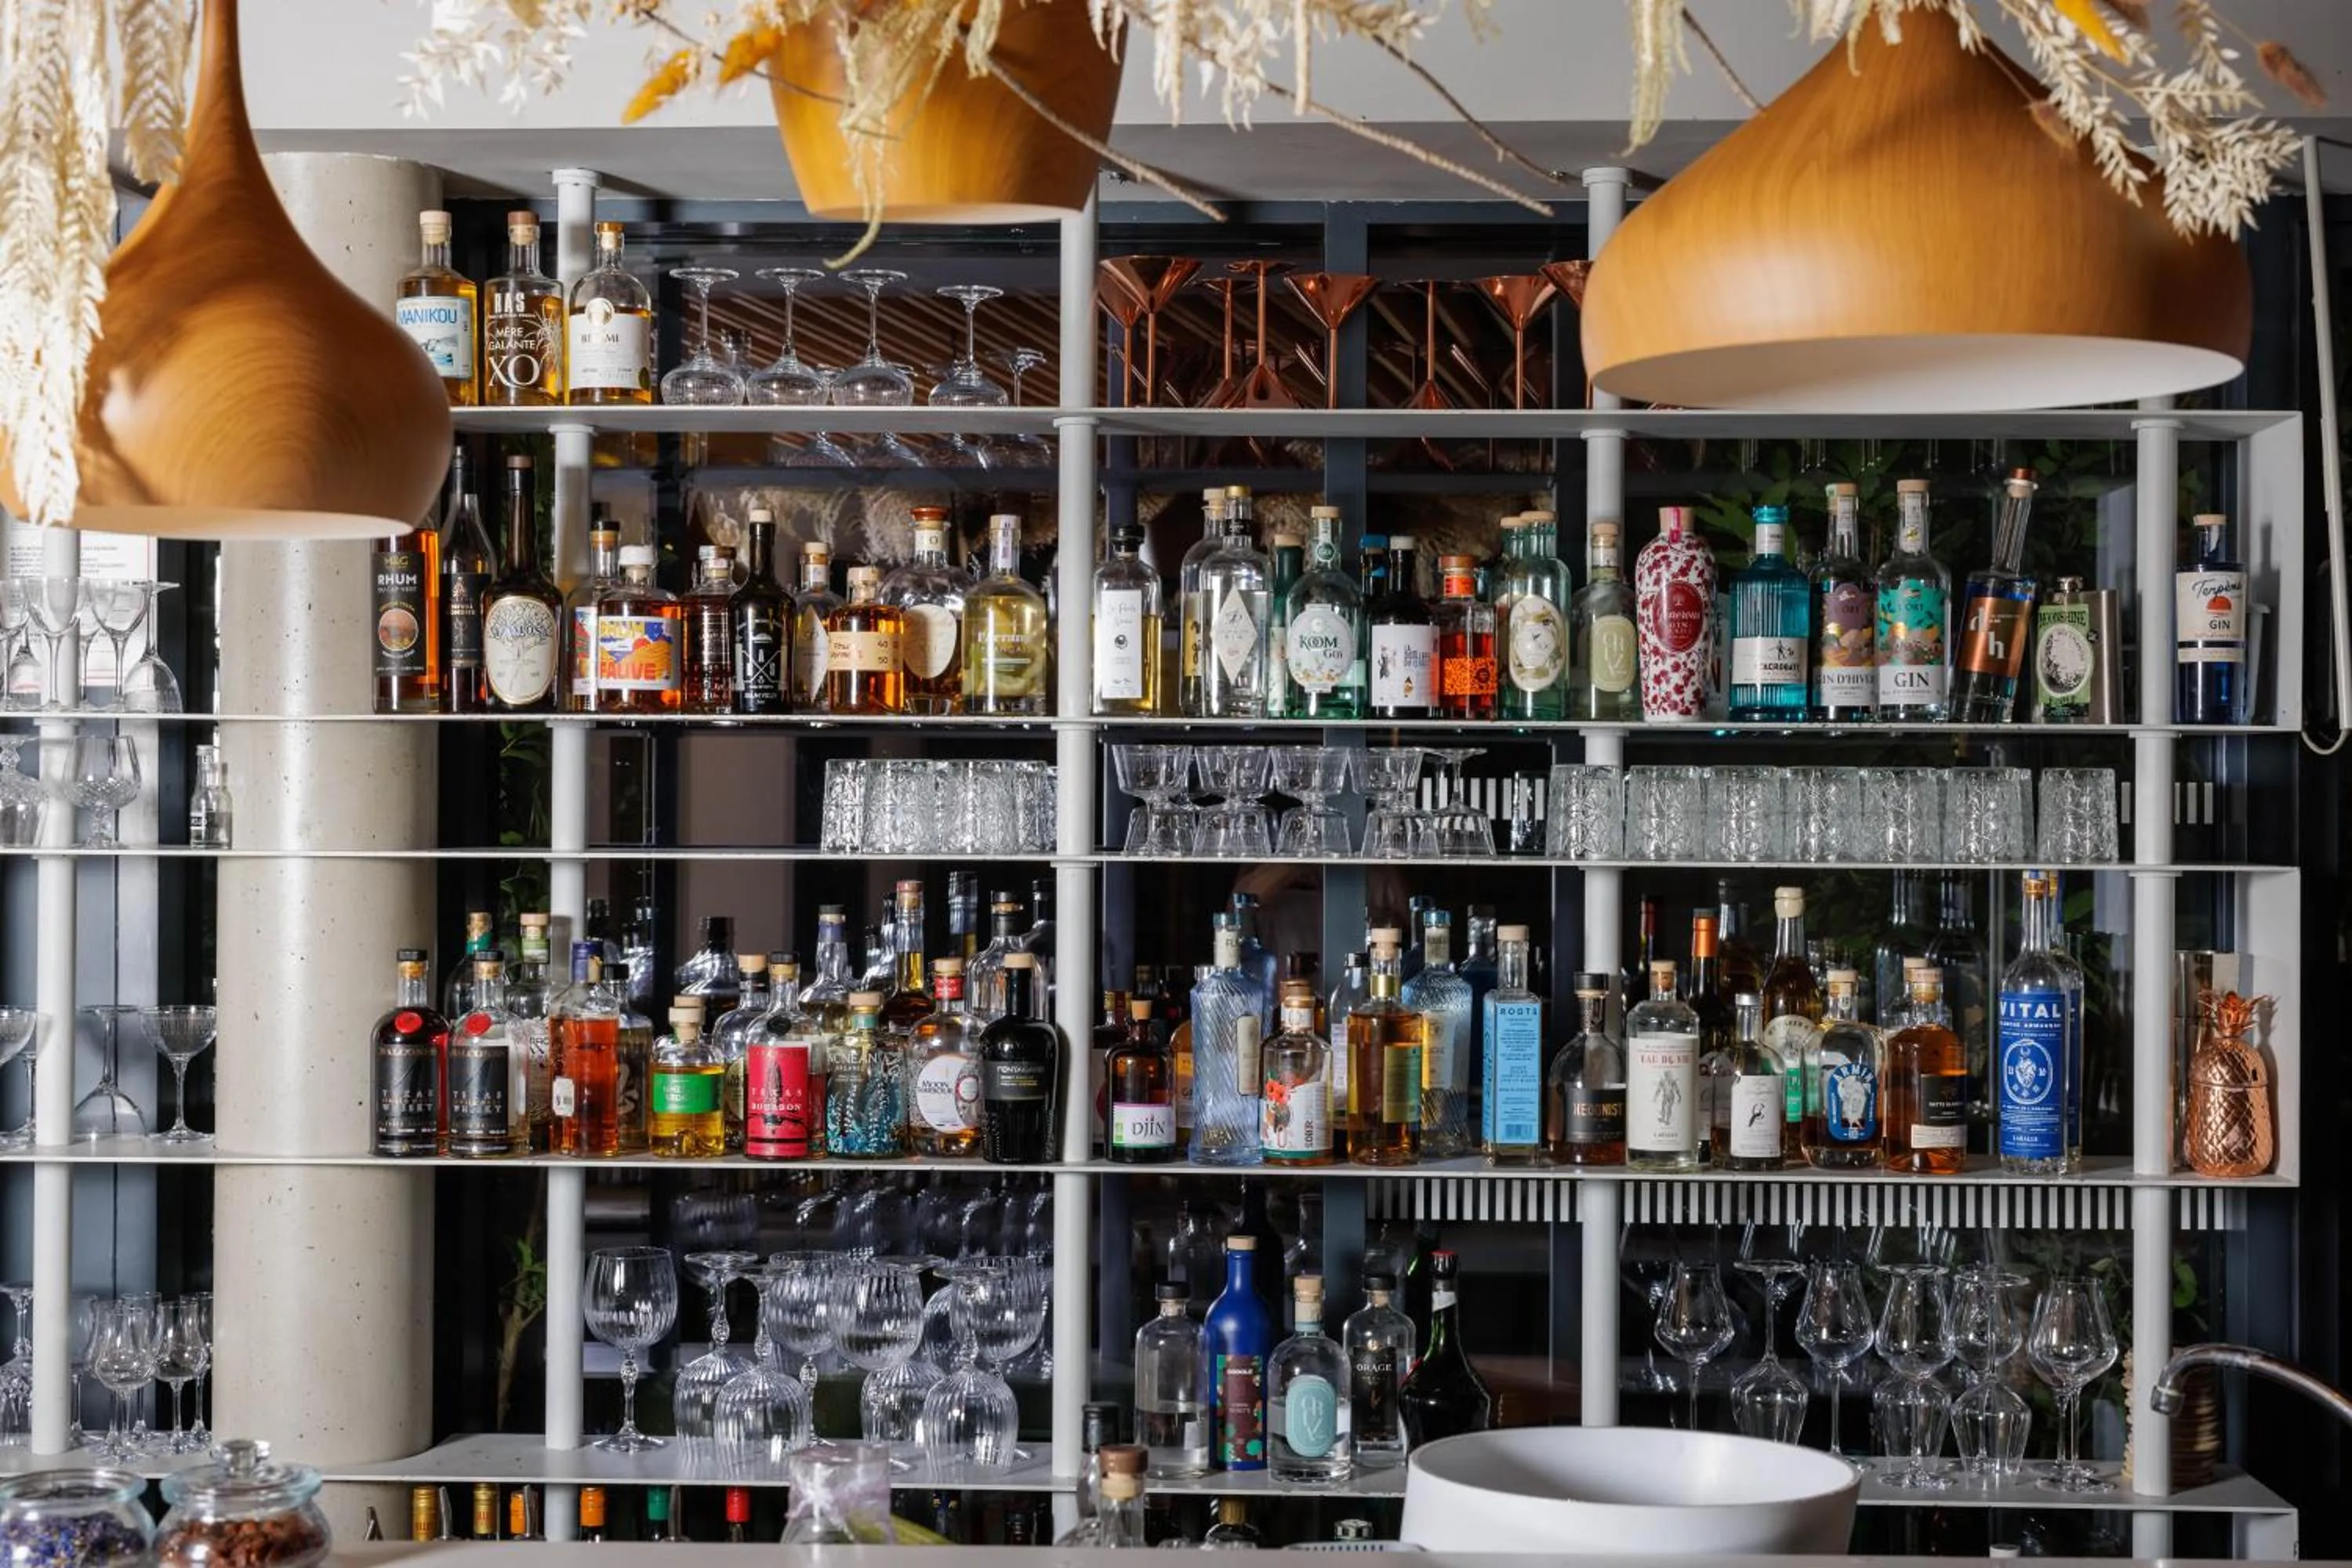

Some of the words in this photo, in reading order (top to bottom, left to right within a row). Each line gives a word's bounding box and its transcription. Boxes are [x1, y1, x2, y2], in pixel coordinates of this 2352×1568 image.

[488, 340, 536, 350] GALANTE
[488, 354, 540, 387] XO
[377, 573, 418, 586] RHUM
[2209, 619, 2230, 630] GIN
[1299, 634, 1338, 651] KOOM
[1893, 671, 1930, 688] GIN
[2000, 1001, 2061, 1018] VITAL
[382, 1089, 434, 1098] TXAS
[452, 1090, 503, 1099] TEAS
[1356, 1363, 1392, 1373] ORAGE
